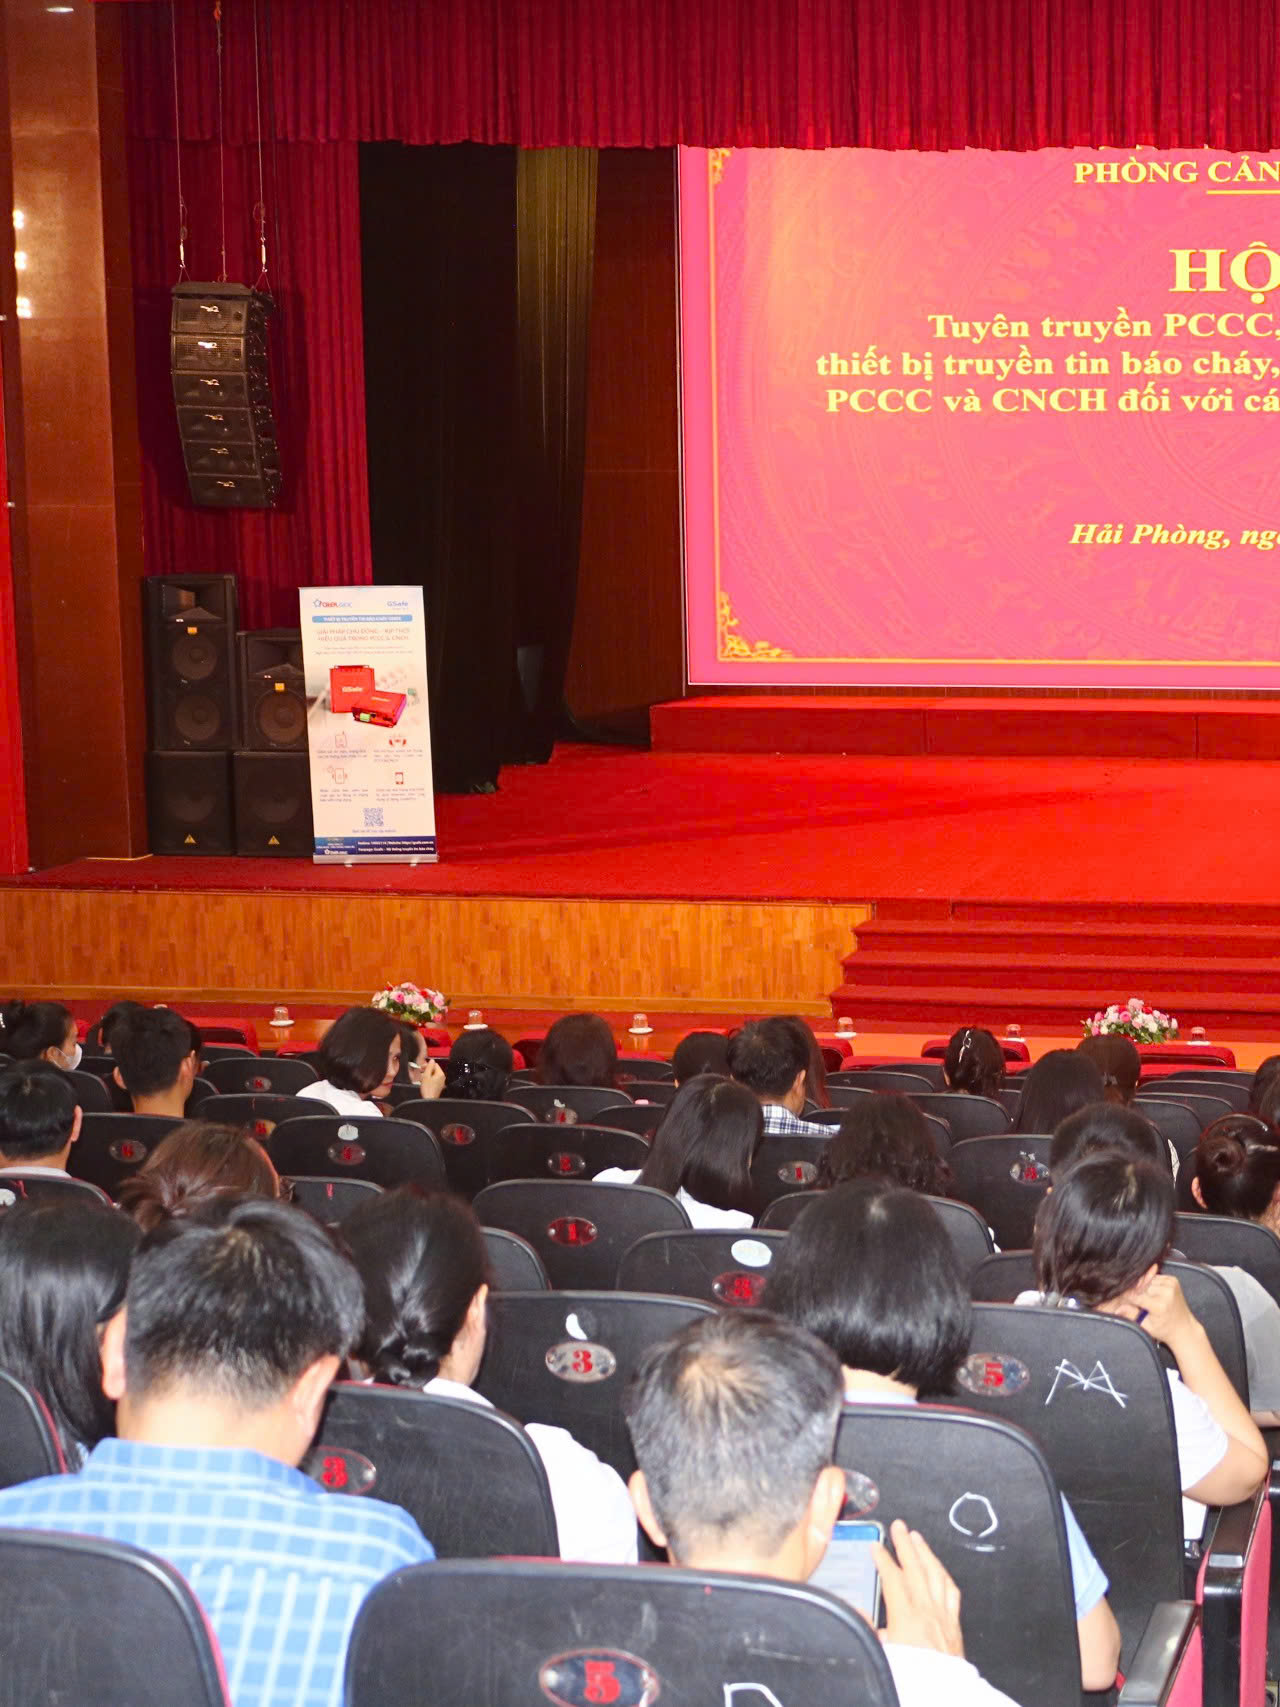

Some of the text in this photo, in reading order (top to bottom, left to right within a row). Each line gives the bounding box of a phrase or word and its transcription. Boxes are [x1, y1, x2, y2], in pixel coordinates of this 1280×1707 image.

[1074, 156, 1199, 184] PHÒNG
[927, 313, 1032, 346] Tuyên
[1040, 306, 1153, 344] truyền
[815, 344, 892, 377] thiết
[901, 351, 934, 382] bị
[943, 344, 1054, 382] truyền
[1065, 351, 1110, 375] tin
[1121, 350, 1183, 375] báo
[1192, 350, 1280, 381] cháy,
[825, 388, 933, 413] PCCC
[943, 388, 982, 413] và
[991, 387, 1107, 413] CNCH
[1117, 381, 1171, 412] đối
[1180, 387, 1233, 412] với
[1069, 523, 1124, 545] Hải
[1130, 523, 1231, 550] Phòng,
[572, 1349, 593, 1374] 3
[983, 1362, 1004, 1387] 5
[322, 1456, 347, 1488] 3
[584, 1660, 622, 1705] 5
